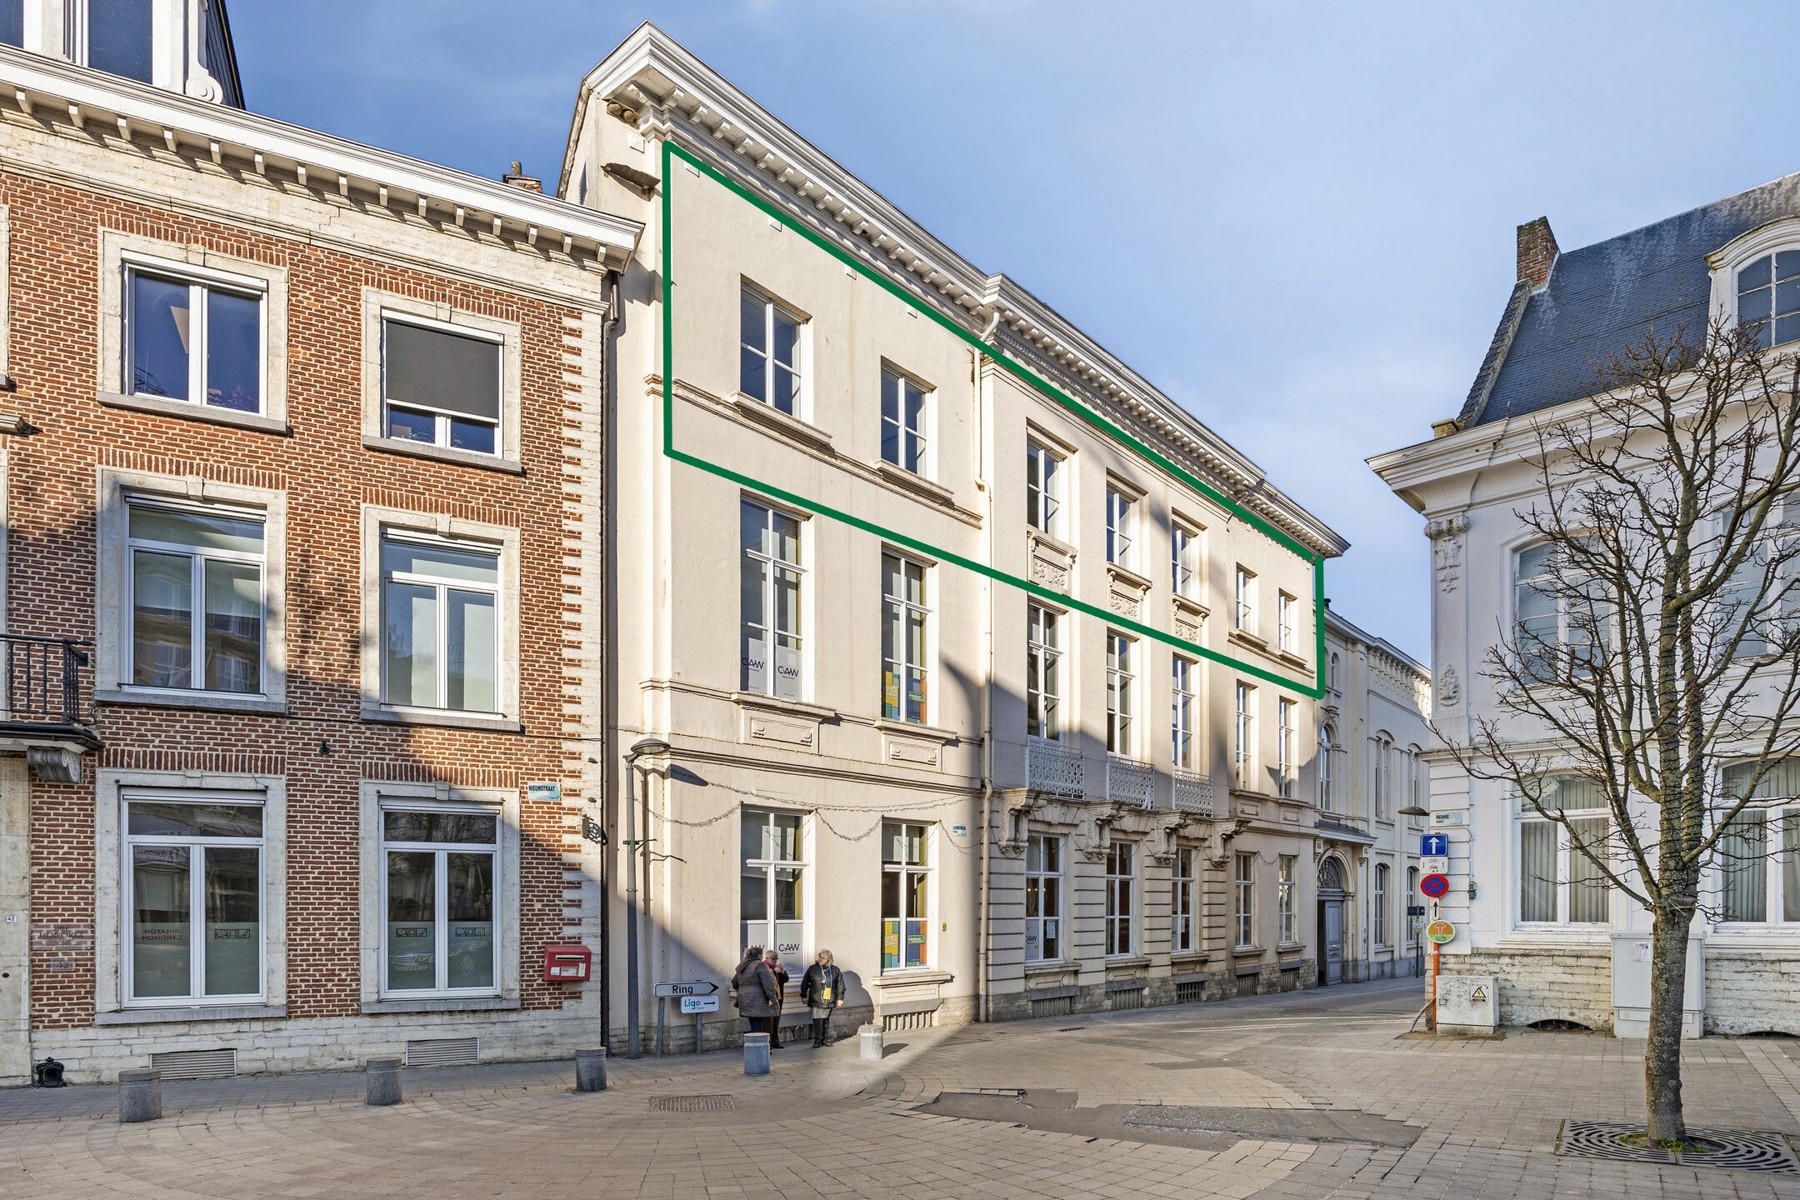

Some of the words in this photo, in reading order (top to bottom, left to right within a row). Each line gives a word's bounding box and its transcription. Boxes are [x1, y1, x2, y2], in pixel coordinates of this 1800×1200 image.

[778, 665, 800, 677] CAW
[778, 943, 800, 952] CAW
[672, 985, 693, 995] Ring
[684, 998, 701, 1009] Ligo
